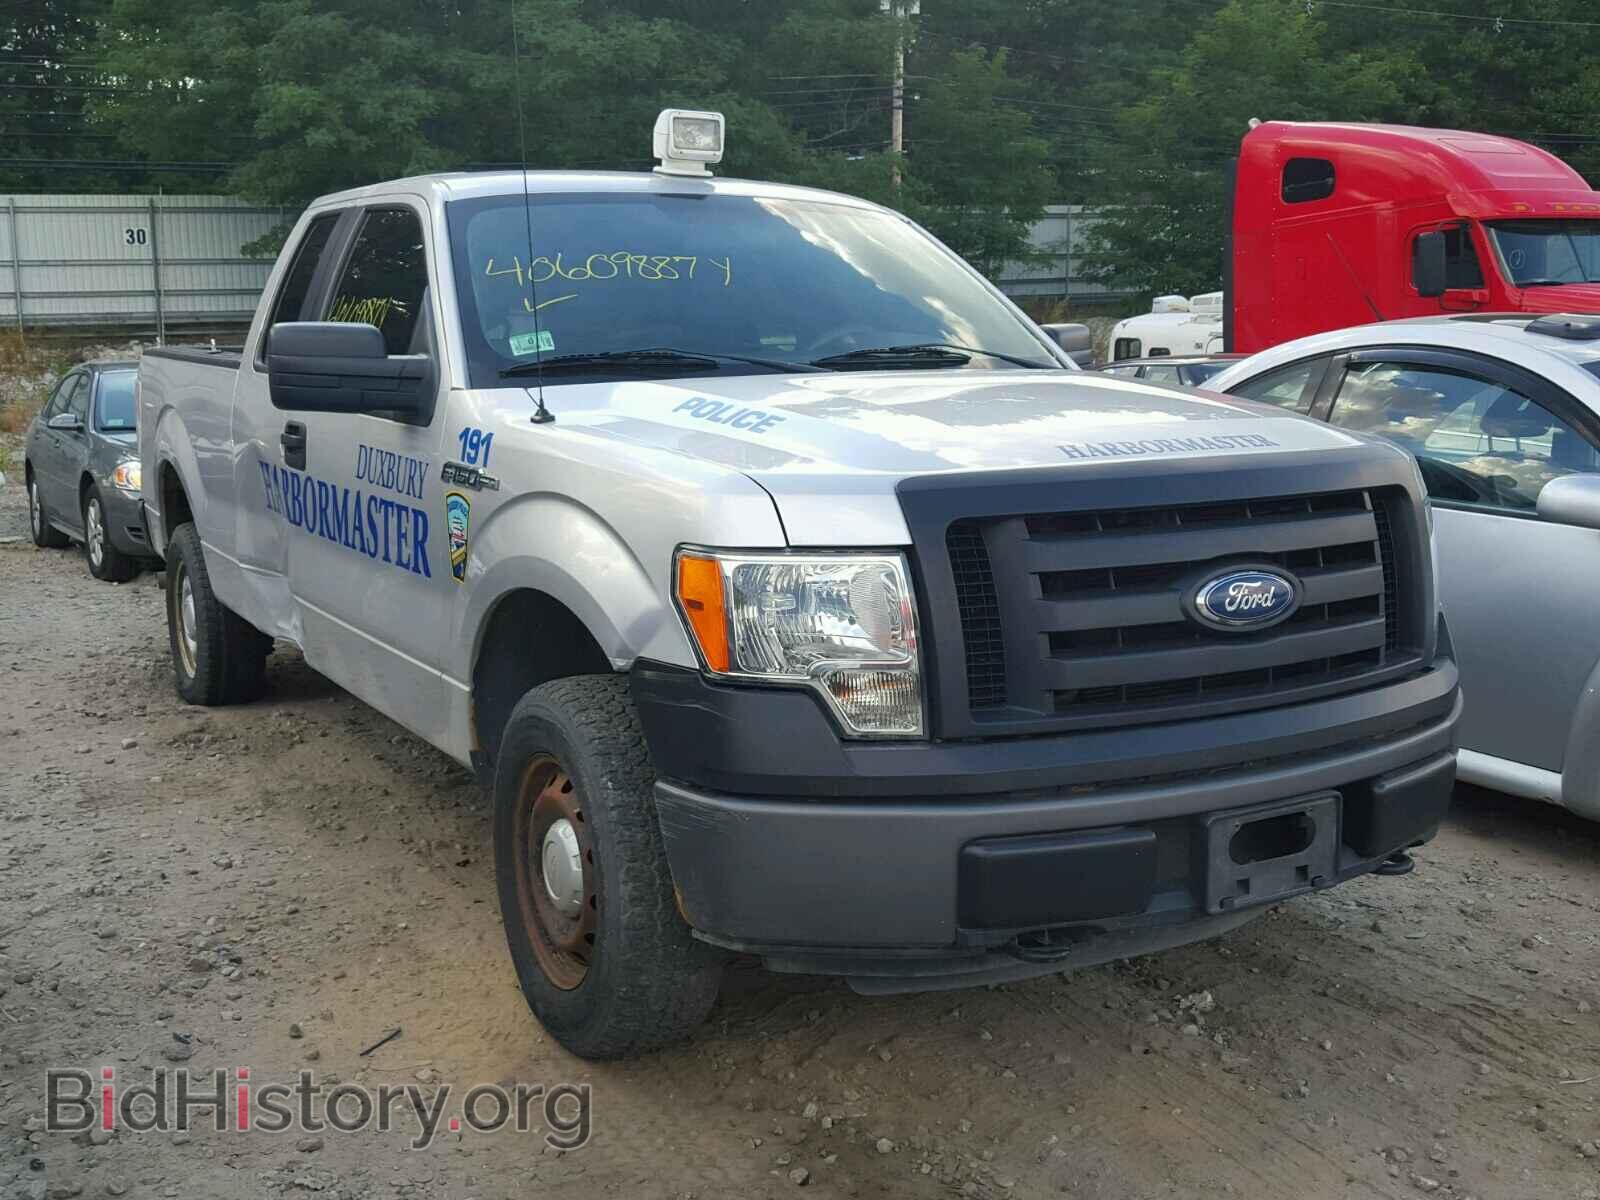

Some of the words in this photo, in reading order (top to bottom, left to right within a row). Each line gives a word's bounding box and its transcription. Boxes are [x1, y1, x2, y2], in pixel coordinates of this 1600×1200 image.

[126, 228, 146, 245] 30
[671, 396, 787, 434] POLICE
[458, 426, 495, 468] 191
[1056, 433, 1281, 459] HARBORMASTER
[356, 444, 429, 499] DUXBURY
[258, 460, 432, 578] HARBORMASTER
[1225, 581, 1276, 612] Ford
